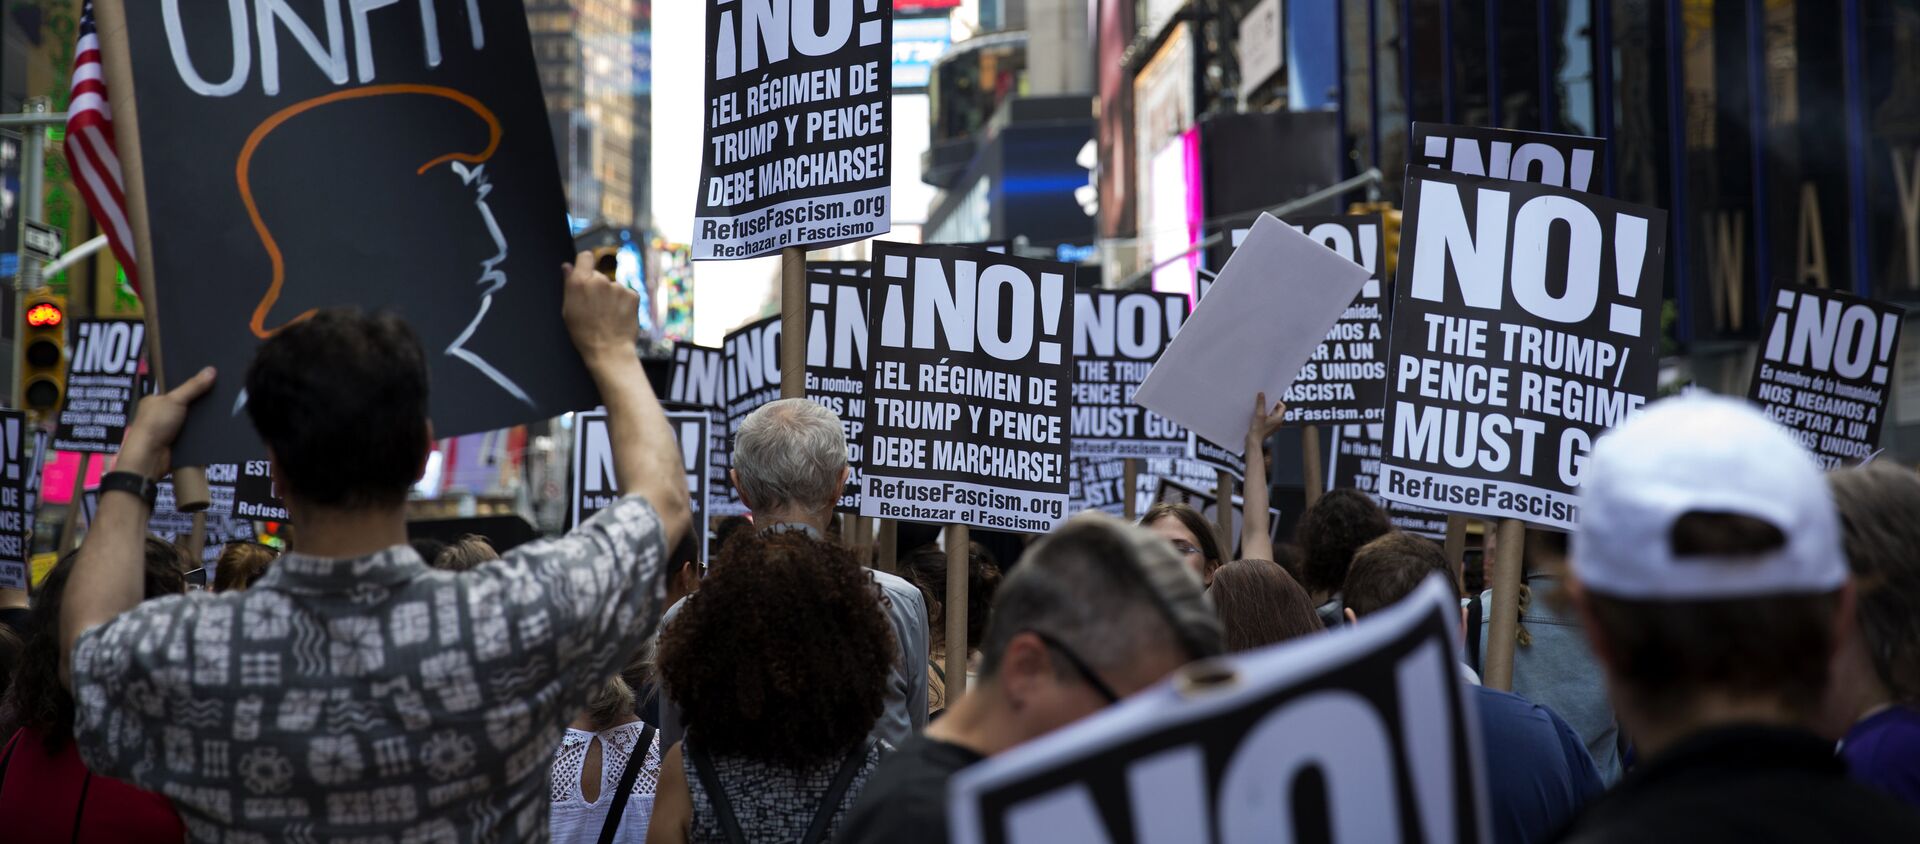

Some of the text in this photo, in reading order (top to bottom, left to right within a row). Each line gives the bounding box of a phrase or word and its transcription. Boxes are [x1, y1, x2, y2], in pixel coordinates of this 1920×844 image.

[716, 0, 882, 80] ¡NO!
[712, 61, 879, 128] ¡EL RÉGIMEN DE
[712, 101, 883, 166] TRUMP Y PENCE
[706, 143, 885, 207] DEBE MARCHARSE!
[702, 195, 885, 240] RefuseFascism.org
[713, 221, 874, 257] Rechazar el Fascismo
[1411, 179, 1648, 337] NO!
[806, 283, 867, 371] ¡N
[881, 254, 1064, 365] ¡NO!
[1340, 303, 1382, 320] anidad,
[1368, 323, 1381, 340] A
[72, 321, 145, 374] ¡NO!
[1333, 343, 1346, 360] A
[1349, 343, 1374, 360] UN
[1423, 312, 1630, 388] THE TRUMP/
[1765, 289, 1899, 385] ¡NO!
[725, 320, 781, 405] ¡NO
[805, 372, 863, 394] En nombre
[874, 357, 1057, 407] ¡EL RÉGIMEN DE
[1077, 361, 1109, 381] THE
[1322, 362, 1386, 380] UNIDOS
[1396, 354, 1509, 407] PENCE
[1071, 383, 1120, 404] PENCE
[1283, 383, 1355, 402] ASCISTA
[1758, 383, 1877, 424] NOS NEGAMOS A
[1760, 364, 1882, 407] En nombre de la humanidad,
[874, 397, 961, 431] TRUMP
[968, 405, 983, 434] Y
[989, 408, 1062, 444] PENCE
[1071, 405, 1138, 437] MUST
[1283, 407, 1385, 421] eFascism.or
[1764, 403, 1868, 441] ACEPTAR A UN
[584, 420, 700, 492] N!
[872, 435, 926, 469] DEBE
[932, 440, 1062, 484] MARCHARSE!
[1391, 400, 1545, 477] MUST
[1820, 434, 1872, 460] UNIDOS
[3, 487, 18, 506] DE
[869, 477, 1062, 519] RefuseFascism.org
[879, 502, 1050, 531] Rechazar el Fascismo
[1389, 469, 1580, 524] RefuseFascism
[0, 512, 21, 531] NCE
